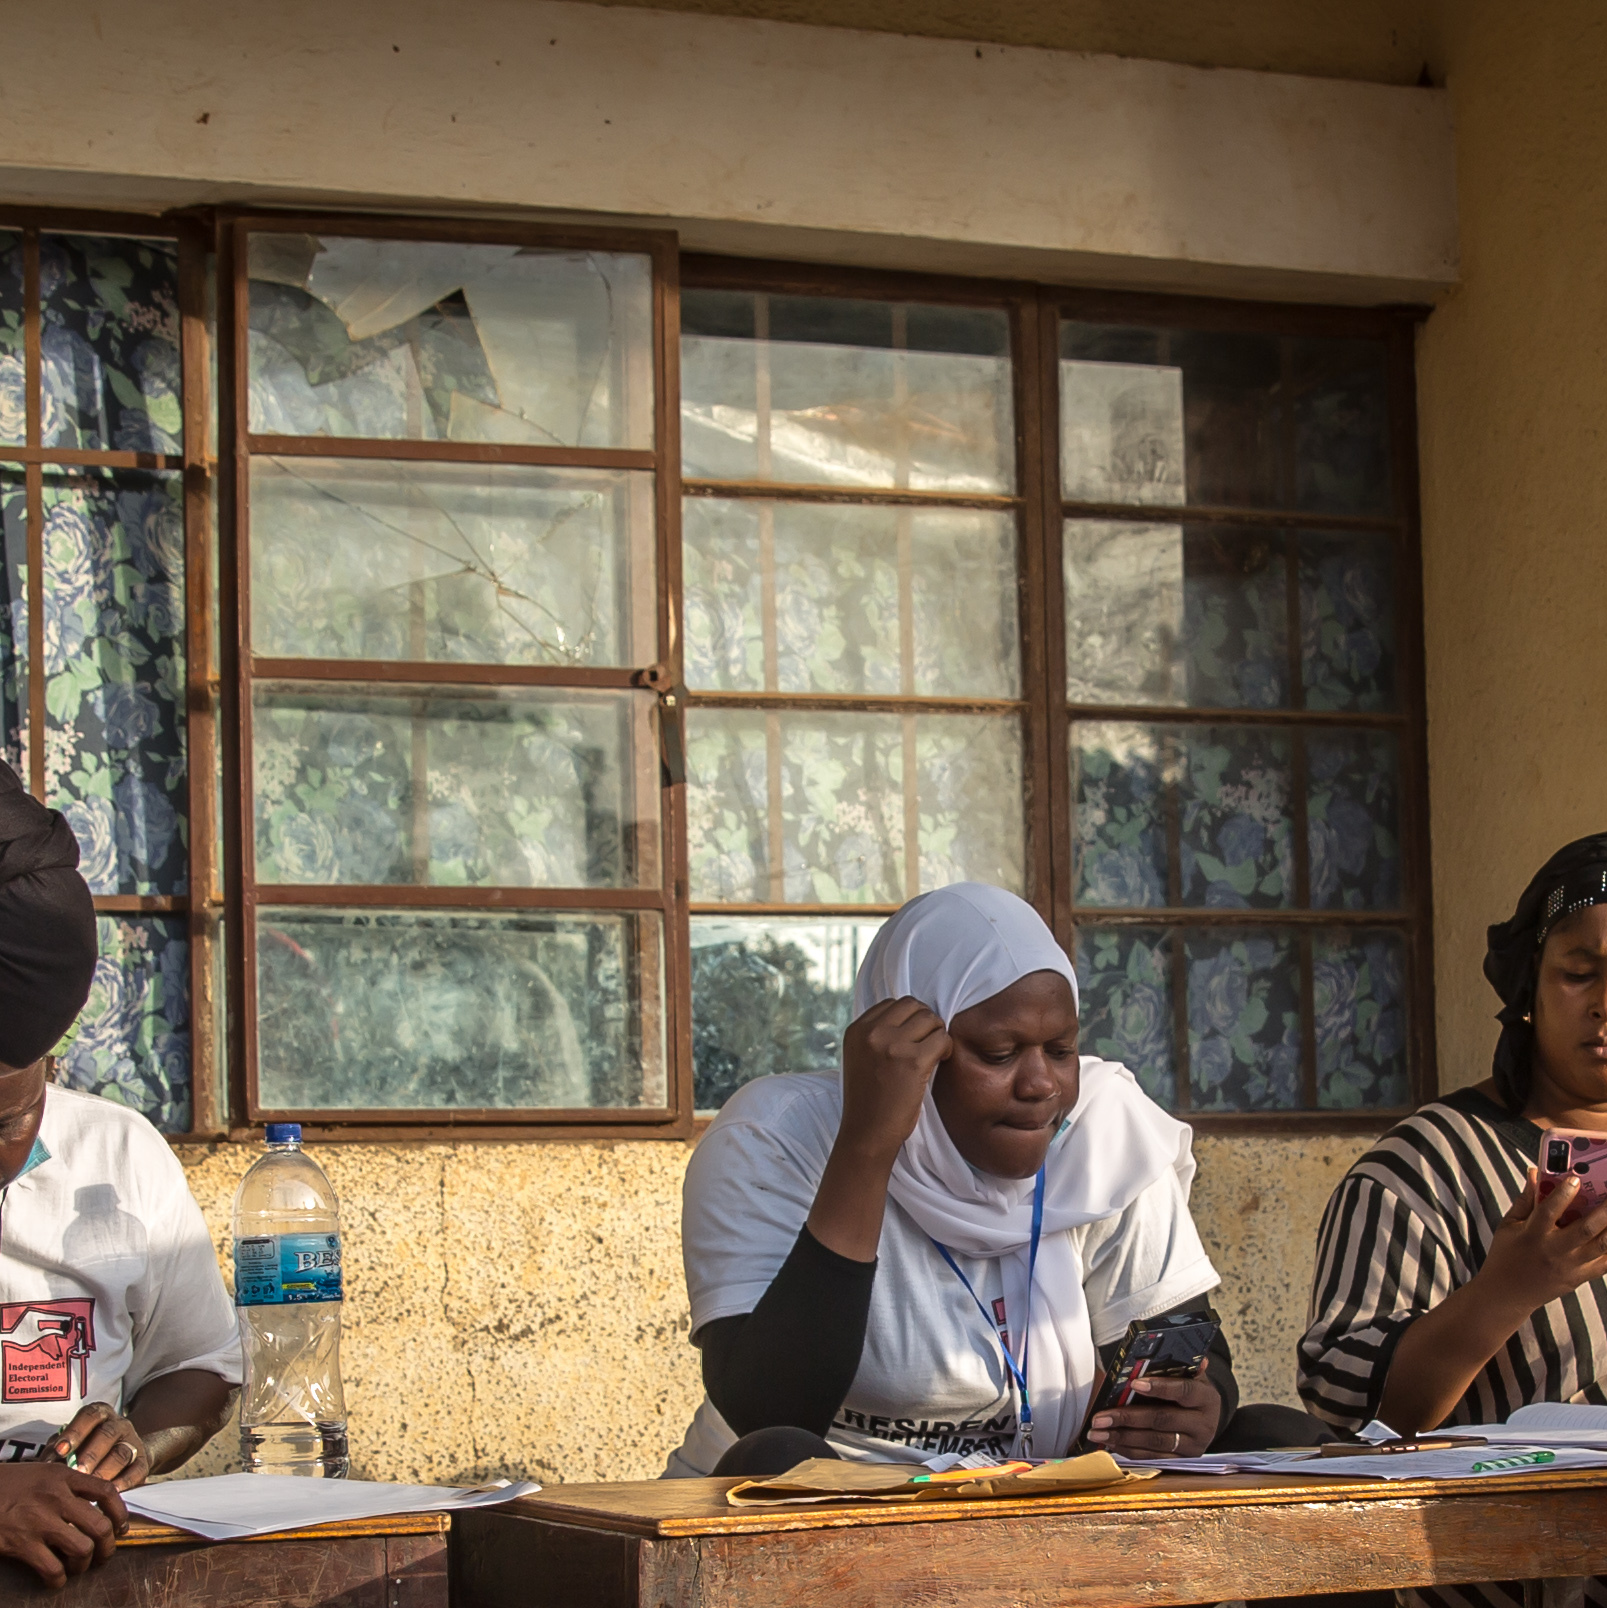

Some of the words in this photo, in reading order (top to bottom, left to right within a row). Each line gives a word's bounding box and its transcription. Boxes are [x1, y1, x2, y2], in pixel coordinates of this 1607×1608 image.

[8, 1361, 65, 1372] Independent
[8, 1373, 49, 1382] Electoral
[8, 1385, 64, 1394] Commission
